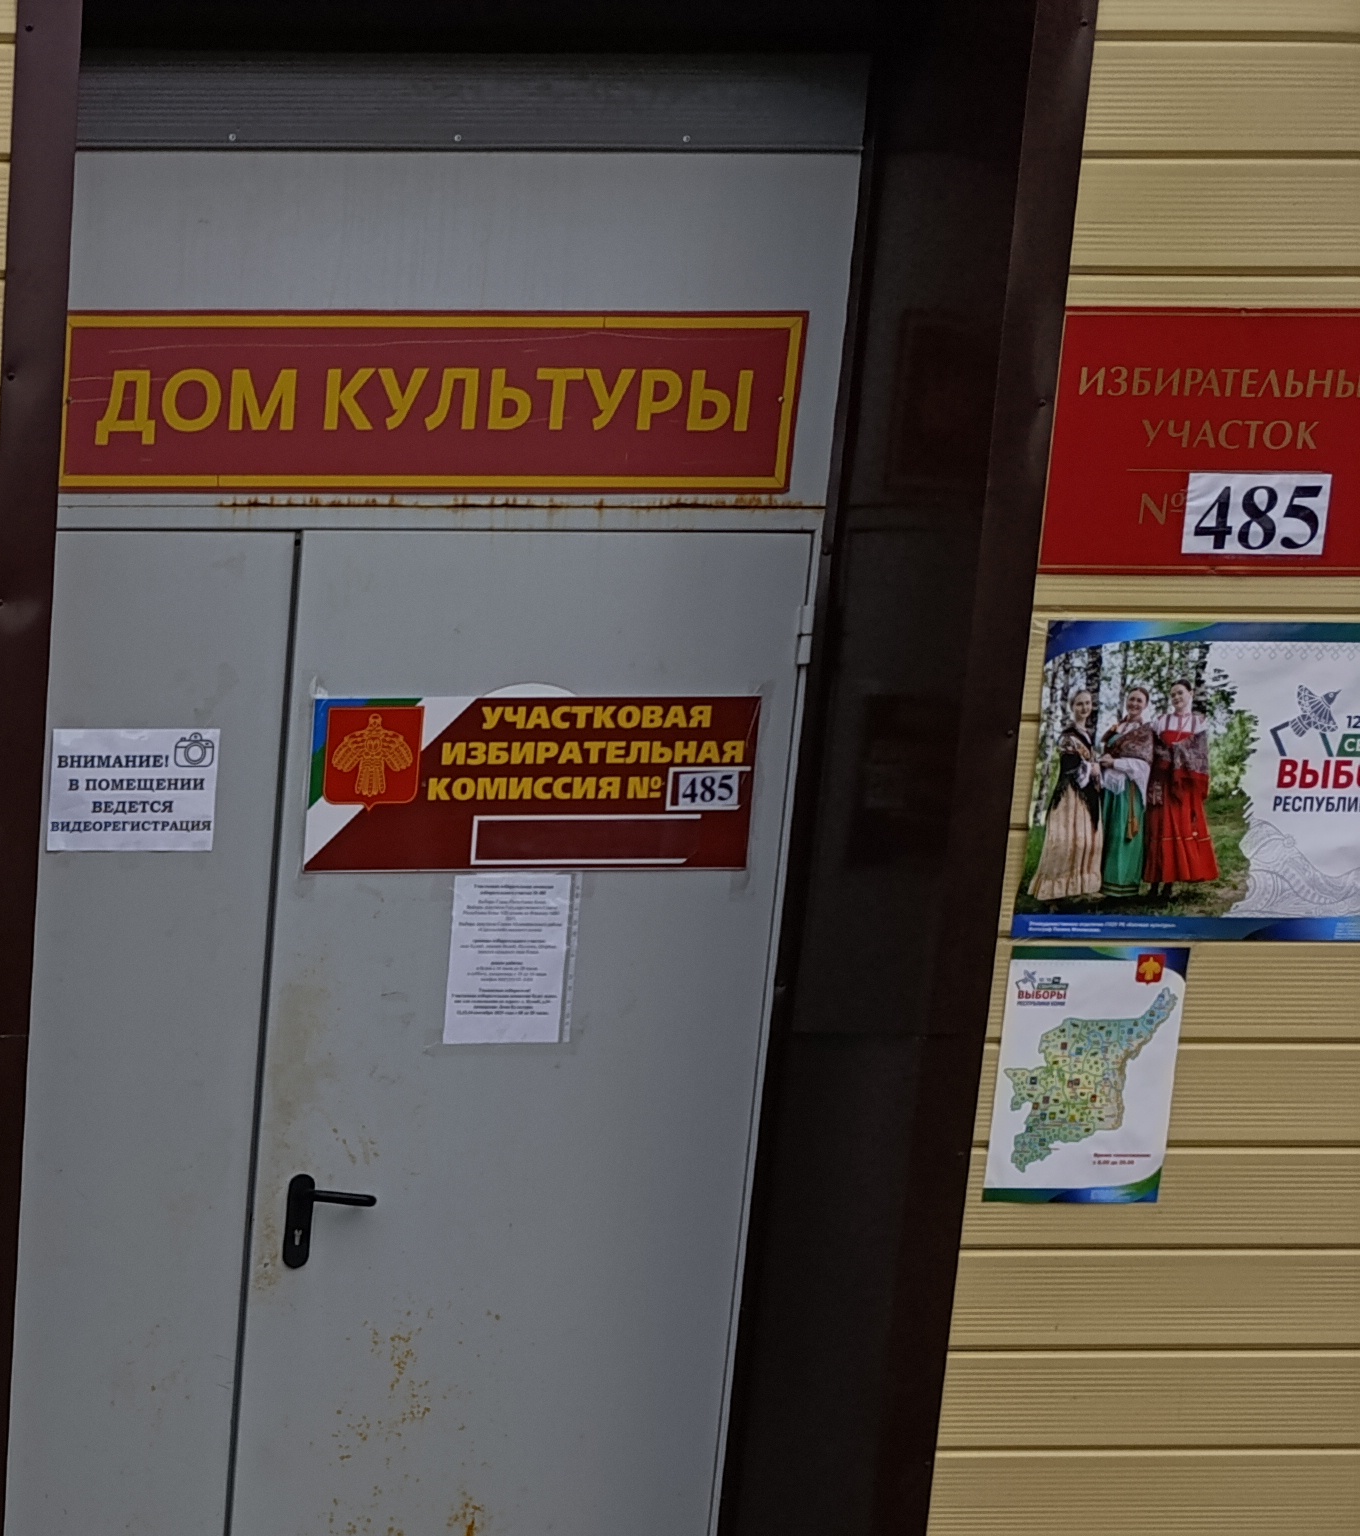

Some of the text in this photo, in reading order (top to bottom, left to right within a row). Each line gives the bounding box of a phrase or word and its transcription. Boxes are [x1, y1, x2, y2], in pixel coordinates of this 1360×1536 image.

[94, 367, 754, 446] ДОМ КУЛЬТУРЫ
[1142, 418, 1320, 451] УЧАСТОК
[1194, 485, 1324, 551] 485
[481, 704, 712, 730] УЧАСТКОВАЯ
[57, 755, 169, 769] ВНИМАНИЕ!
[441, 740, 745, 766] ИЗБИРАТЕЛЬНАЯ
[68, 778, 205, 792] В ПОМЕЩЕНИИ
[1276, 758, 1360, 789] ВЫБ
[427, 774, 734, 803] КОМИССИЯ № 485
[91, 800, 174, 815] ВЕДЕТСЯ
[50, 820, 212, 833] ВИДЕОРЕГИСТРАЦИЯ
